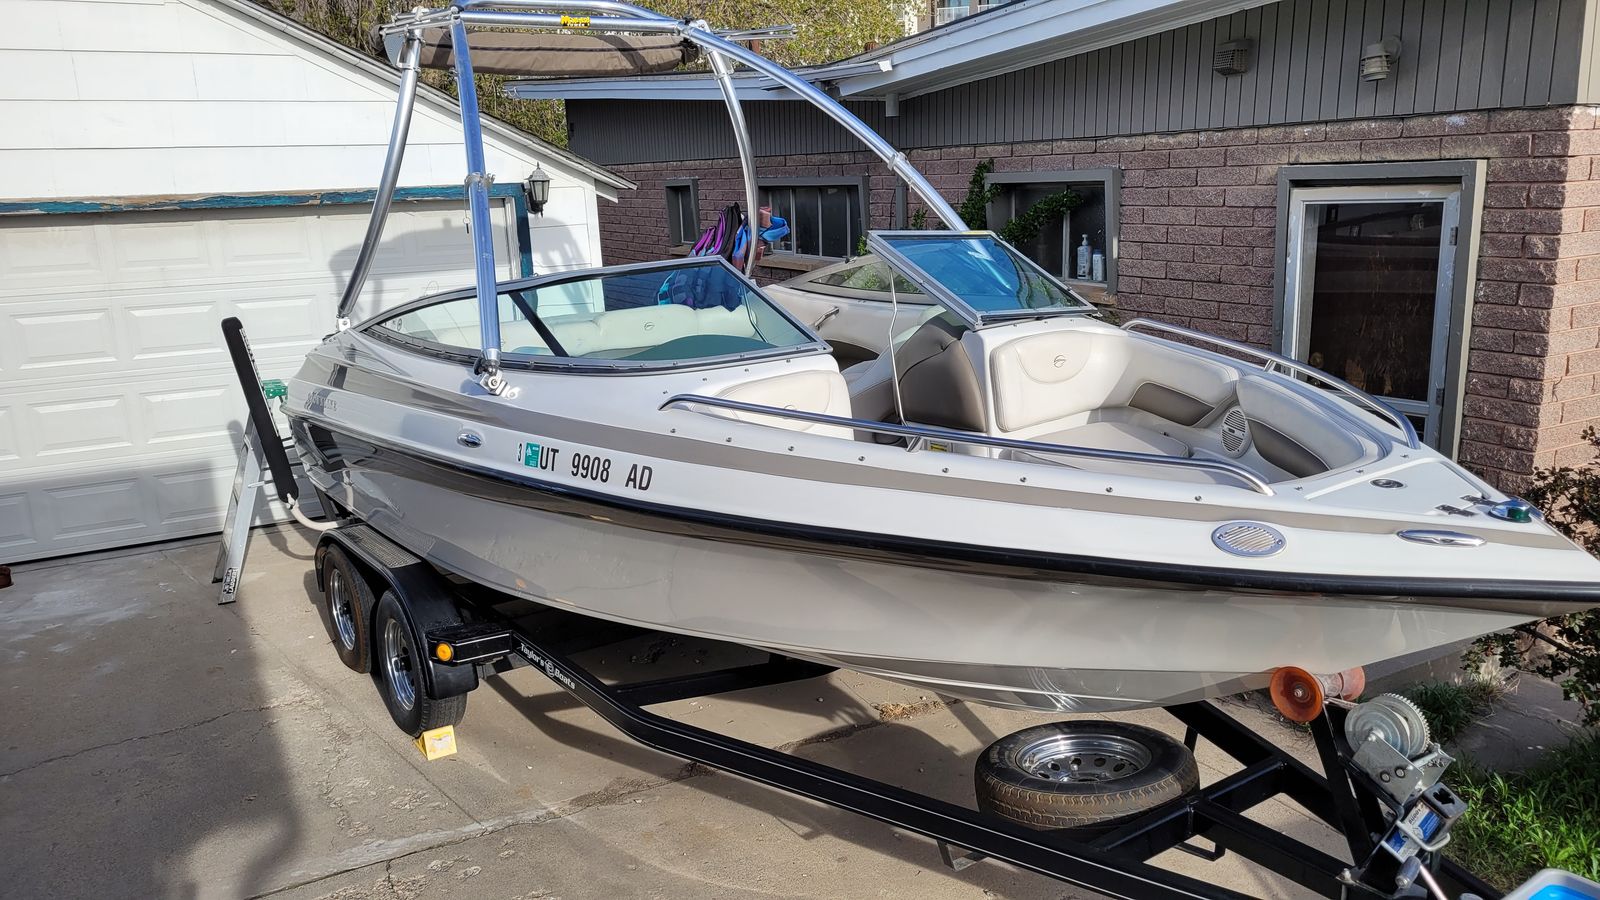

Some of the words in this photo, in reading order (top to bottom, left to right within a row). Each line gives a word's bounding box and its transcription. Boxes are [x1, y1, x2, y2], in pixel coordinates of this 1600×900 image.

[540, 445, 560, 471] UT
[571, 453, 611, 482] 9908
[624, 464, 653, 490] AD
[520, 642, 545, 666] Taylor's
[554, 668, 576, 689] Boats
